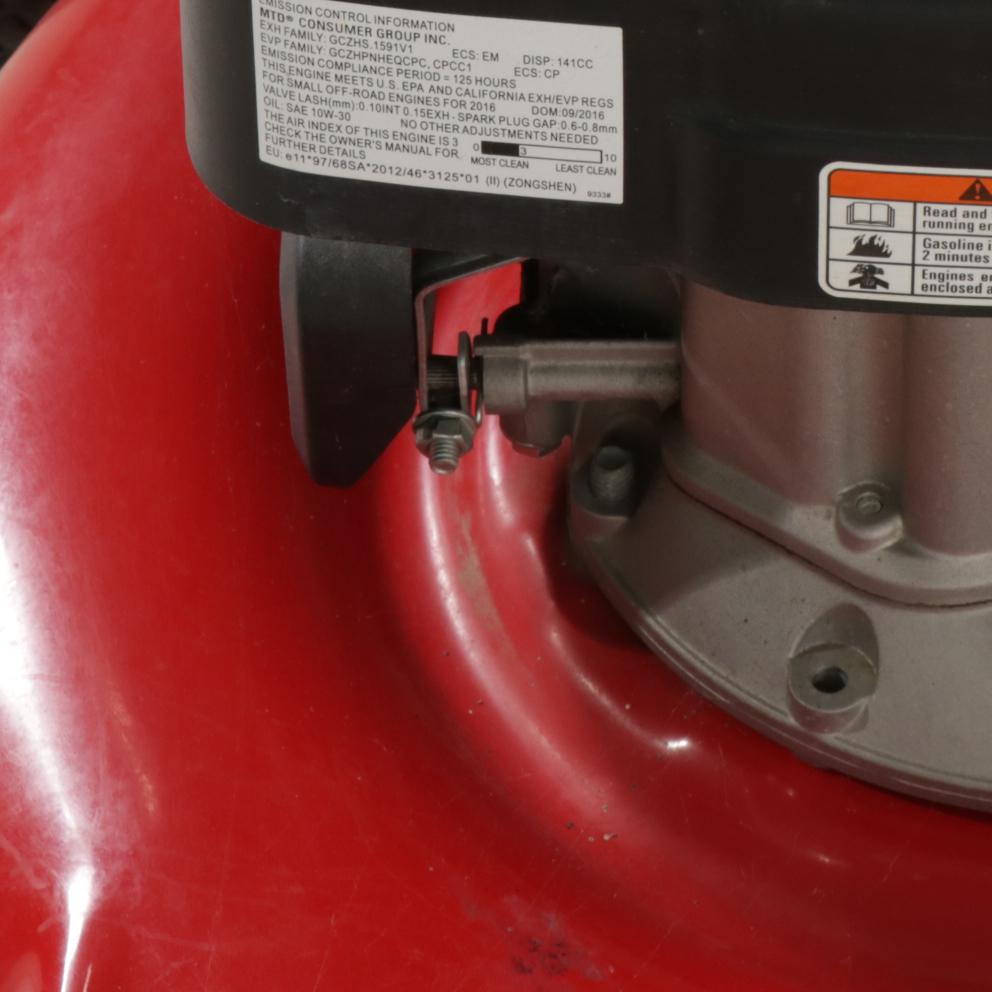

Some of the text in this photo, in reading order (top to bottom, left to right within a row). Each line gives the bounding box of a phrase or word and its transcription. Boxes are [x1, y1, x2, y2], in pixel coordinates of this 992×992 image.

[299, 17, 372, 37] CONSUMER
[376, 28, 420, 42] GROUP
[424, 34, 450, 46] INC.
[315, 8, 371, 24] CONTROL
[374, 15, 455, 32] INFORMATION
[260, 20, 281, 33] EXH
[482, 51, 499, 62] EM
[523, 54, 554, 66] DISP:
[558, 58, 593, 68] 141CC
[260, 32, 281, 46] EVP
[433, 59, 472, 72] CPCC1
[544, 69, 560, 79] CP
[261, 44, 314, 66] EMISSION
[318, 58, 393, 76] COMPLIANCE
[396, 68, 440, 82] PERIOD
[454, 74, 472, 86] 125
[474, 76, 516, 88] HOURS
[262, 57, 286, 74] THIS
[288, 65, 331, 82] ENGINE
[334, 72, 374, 88] MEETS
[402, 81, 424, 93] EPA
[428, 84, 452, 96] AND
[456, 86, 526, 102] CALIFORNIA
[528, 92, 578, 106] EXH/EVP
[581, 97, 614, 109] REGS
[262, 70, 284, 86] FOR
[286, 78, 322, 94] SMALL
[326, 84, 386, 101] OFF-ROAD
[388, 92, 440, 108] ENGINES
[444, 98, 467, 110] FOR
[470, 101, 496, 112] 2016
[263, 82, 296, 102] VALVE
[458, 112, 496, 124] SPARK
[498, 116, 530, 128] PLUG
[264, 96, 599, 145] OIL: SAE 10W-30 NO OTHER ADJUSTMENTS NEEDED
[264, 109, 458, 147] THE AIR INDEX OF THIS ENGINE IS 3
[264, 121, 460, 159] CHECK THE OWNER'S MANUAL FOR
[264, 132, 366, 160] FURTHER DETAILS
[521, 146, 528, 156] 3
[604, 153, 617, 163] 10
[266, 144, 282, 160] EU:
[504, 177, 577, 194] (ZONGSHEN)
[470, 156, 617, 176] MOST CLEAN LEAST CLEAN
[922, 219, 974, 233] running
[923, 206, 957, 218] Read
[962, 208, 987, 220] and
[922, 250, 930, 261] 2
[934, 250, 990, 264] minutes
[923, 238, 984, 251] Gasoline
[921, 282, 982, 294] enclosed
[922, 269, 974, 282] Engines
